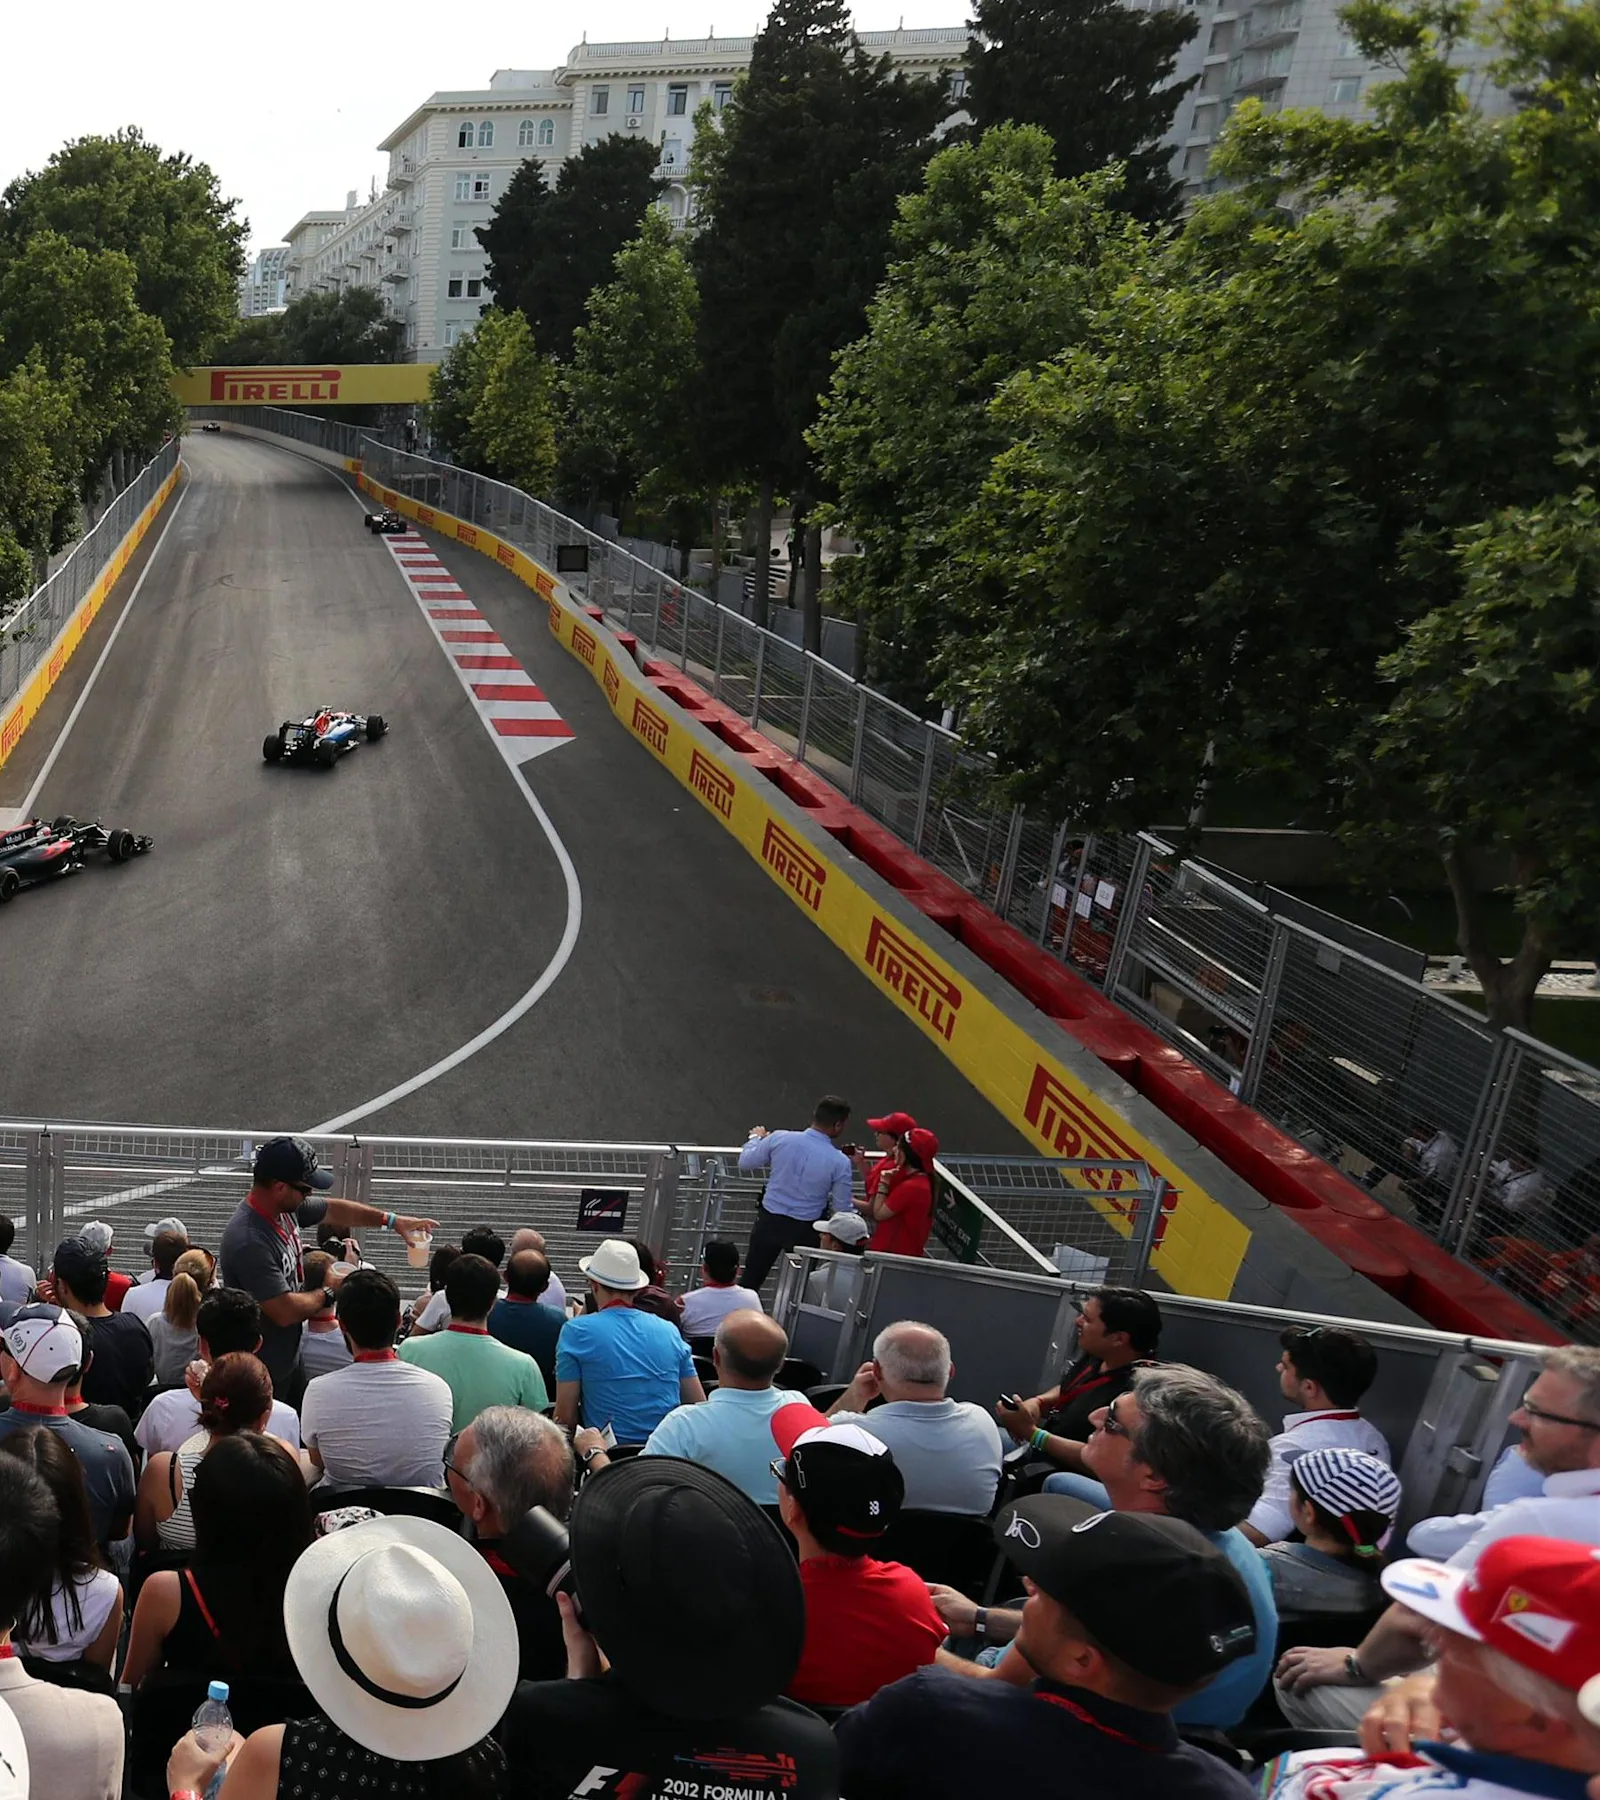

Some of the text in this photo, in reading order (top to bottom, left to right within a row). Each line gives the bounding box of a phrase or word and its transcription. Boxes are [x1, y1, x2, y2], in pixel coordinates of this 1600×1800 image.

[210, 370, 341, 400] PIRELLI
[572, 624, 596, 665] PIRELLI
[1, 705, 25, 757] PIRELLI
[632, 698, 669, 756] PIRELLI
[689, 748, 735, 820] PIRELLI
[761, 818, 826, 911] PIRELLI
[865, 916, 962, 1041] PIRELLI
[663, 1778, 700, 1798] 2012
